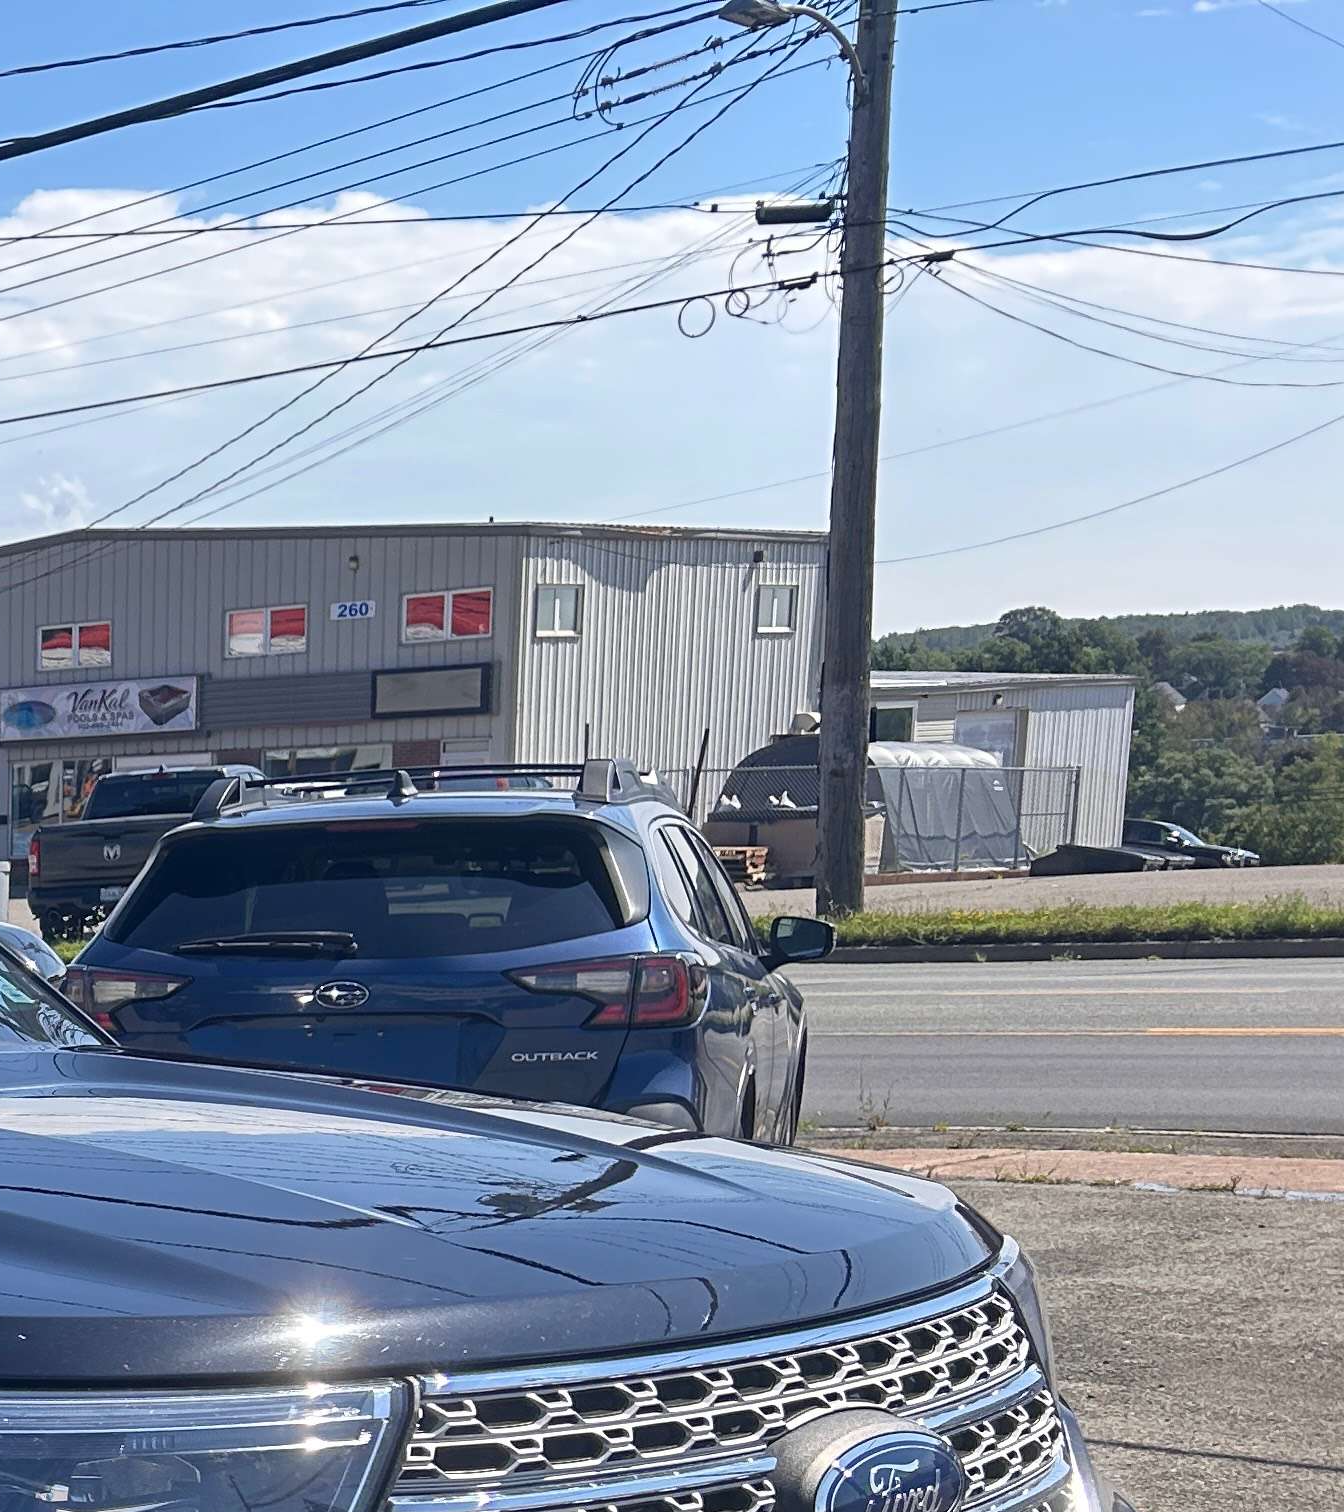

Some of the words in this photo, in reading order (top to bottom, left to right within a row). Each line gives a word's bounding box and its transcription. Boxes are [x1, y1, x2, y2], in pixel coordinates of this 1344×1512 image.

[337, 602, 369, 618] 260
[66, 688, 131, 713] VanKal
[67, 713, 98, 723] POOLS
[110, 711, 135, 721] SPAS
[511, 1051, 599, 1062] OUTBACK
